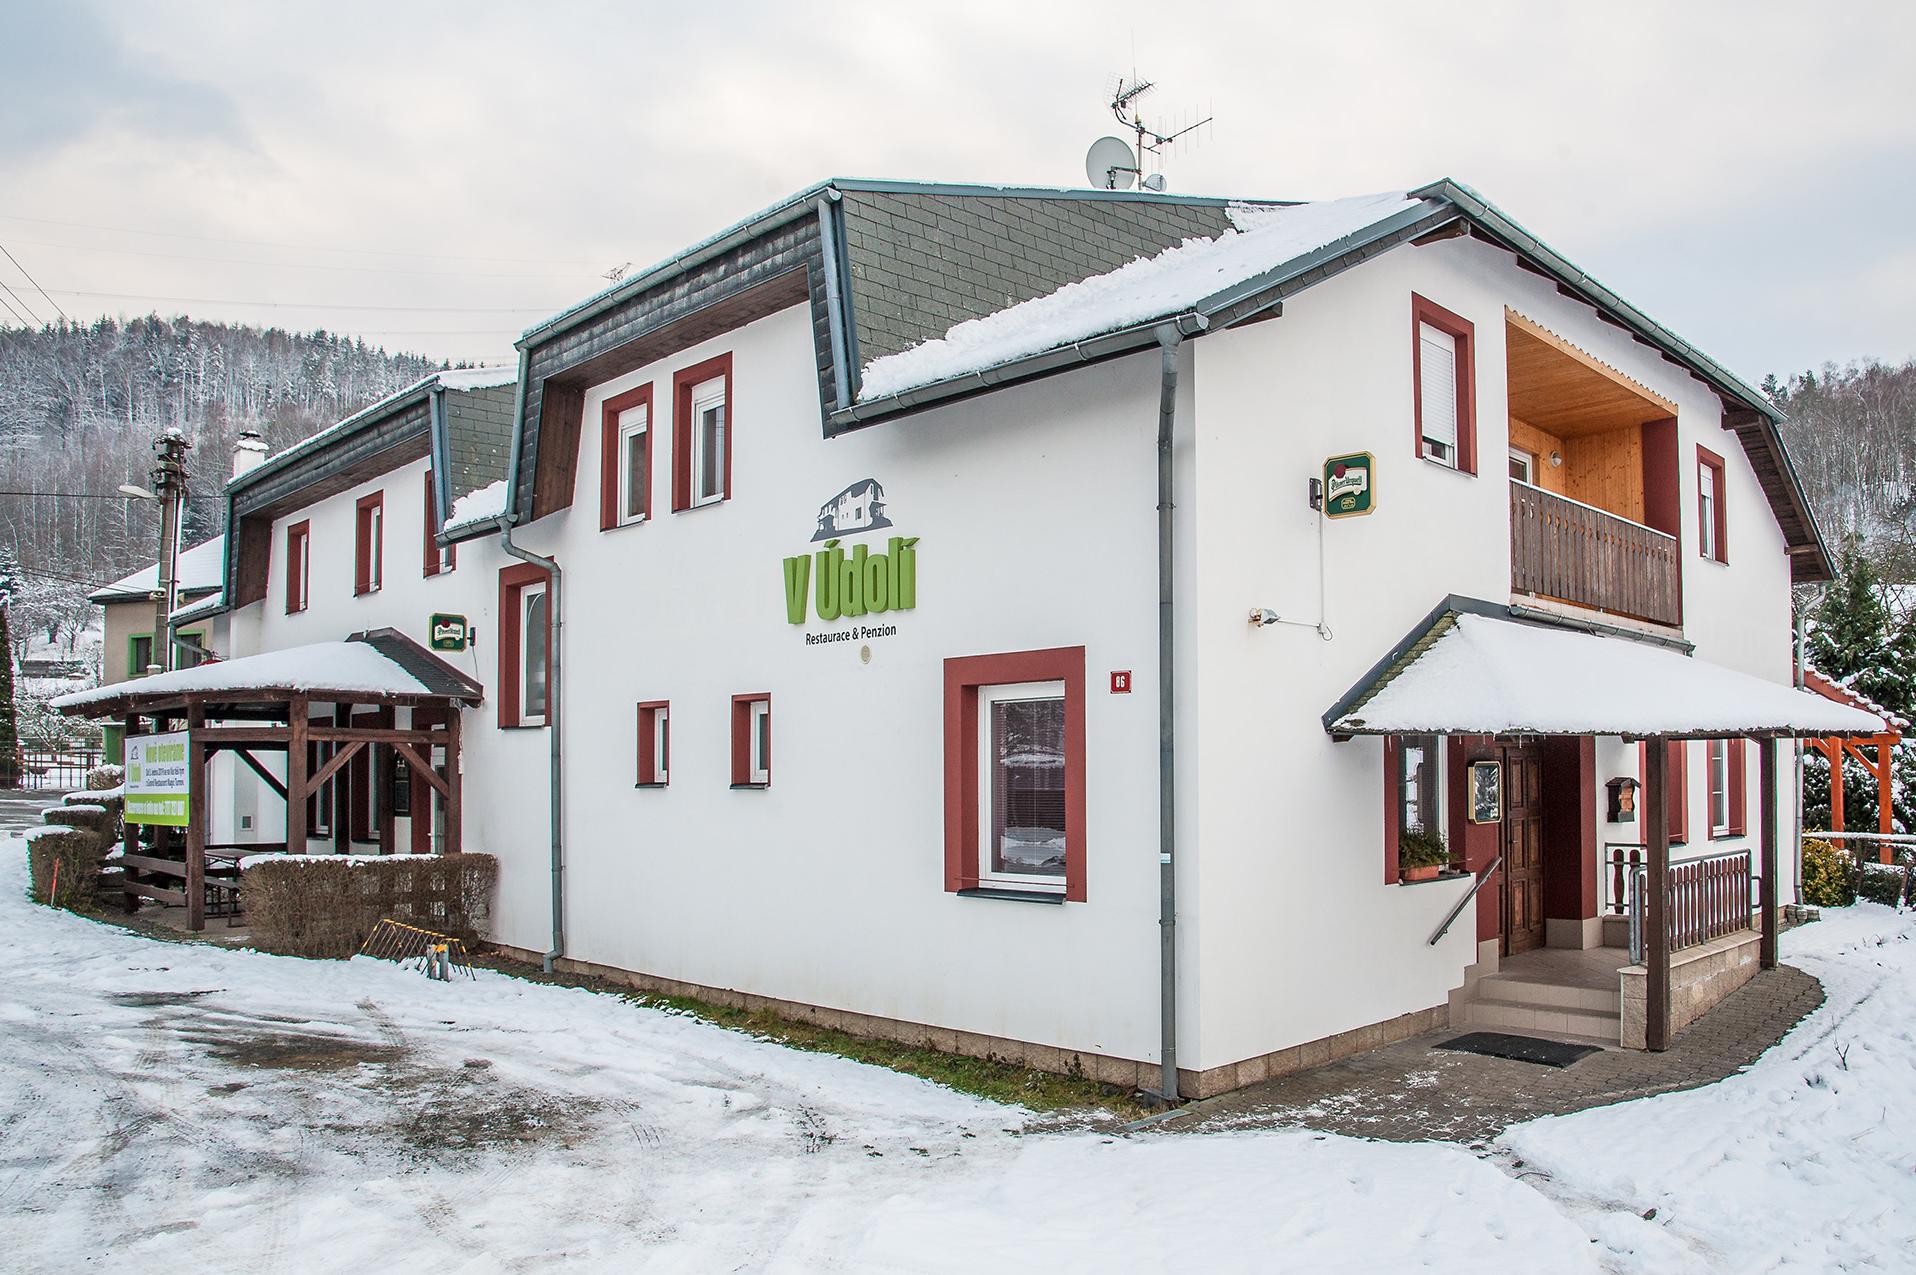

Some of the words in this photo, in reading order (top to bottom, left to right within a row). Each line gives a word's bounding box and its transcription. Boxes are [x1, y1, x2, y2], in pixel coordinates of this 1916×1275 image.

[783, 555, 811, 624] V
[816, 537, 920, 620] Údolí
[806, 631, 850, 645] Restaurace
[852, 627, 859, 640] &
[861, 624, 896, 639] Penzion
